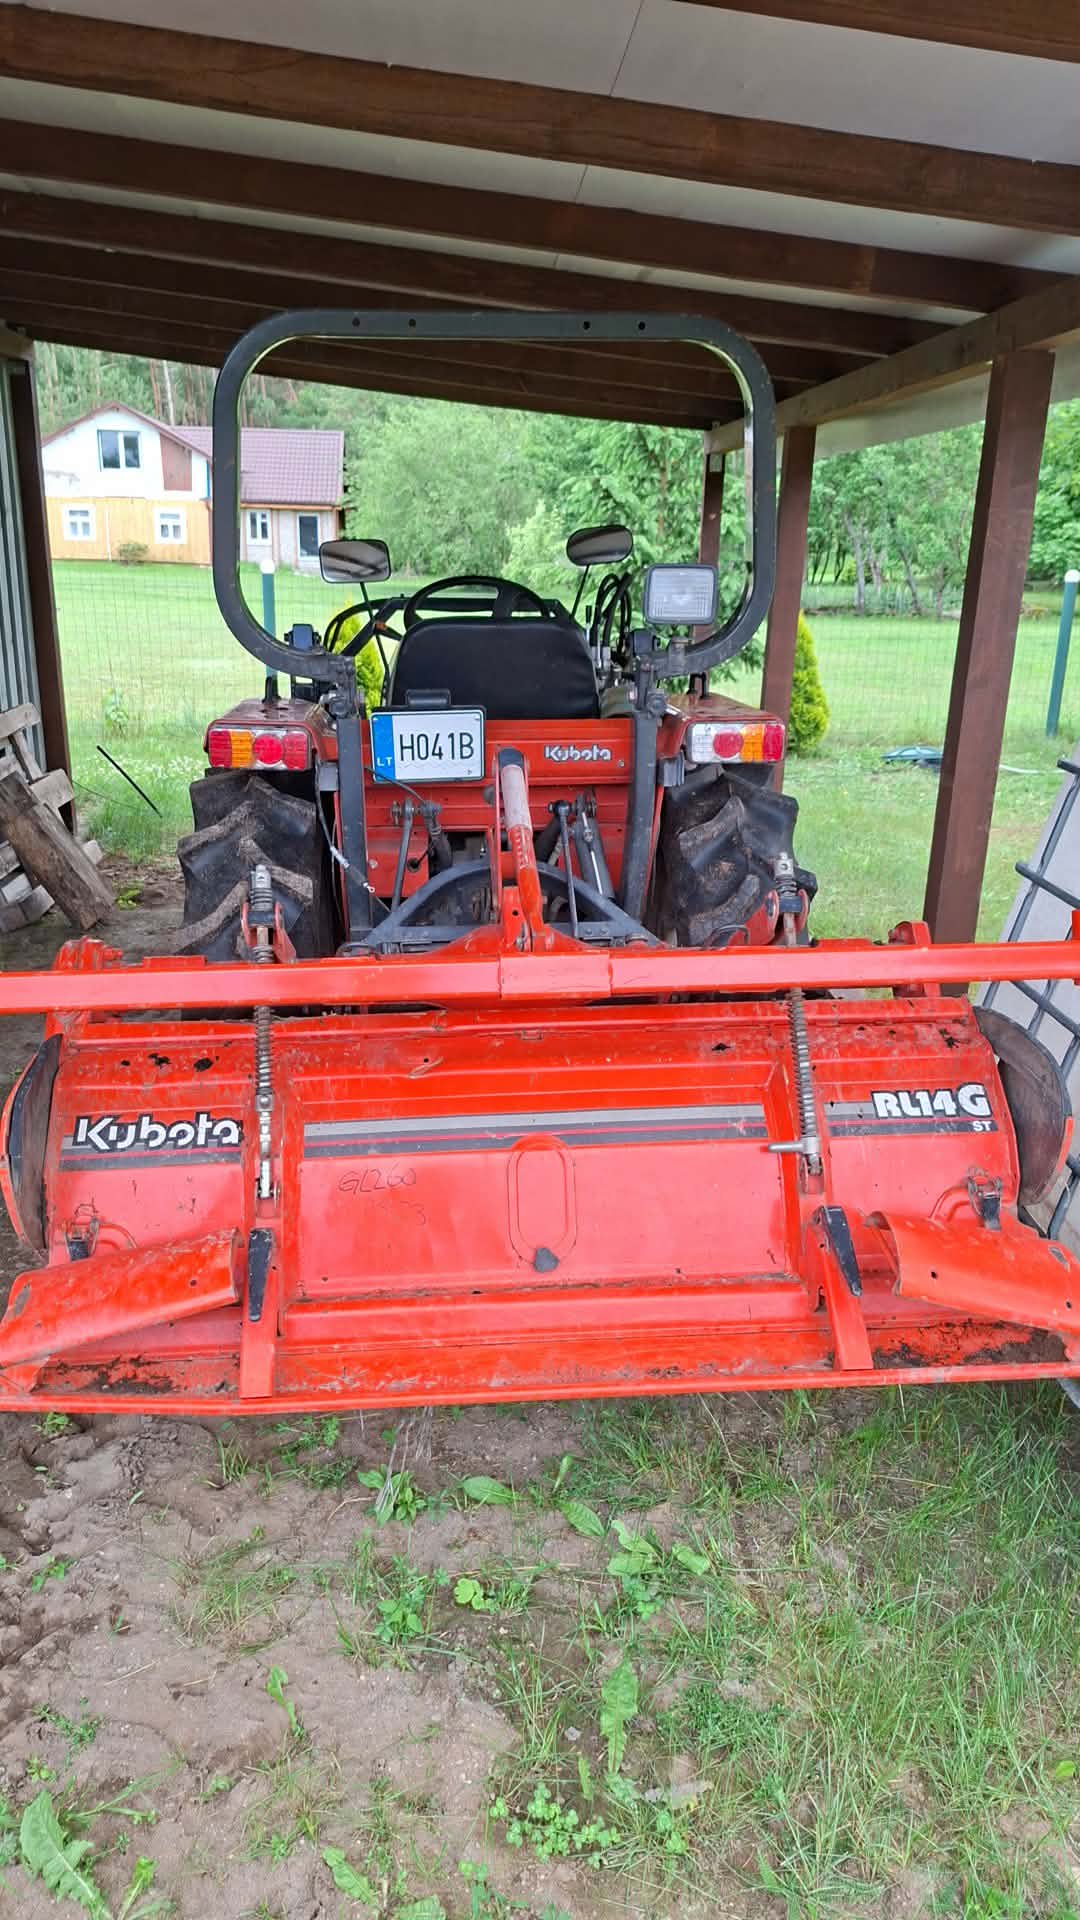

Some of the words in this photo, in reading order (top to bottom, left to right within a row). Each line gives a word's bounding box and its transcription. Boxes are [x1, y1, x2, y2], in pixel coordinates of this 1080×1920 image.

[399, 732, 474, 761] H041B
[544, 744, 612, 762] Kubota
[376, 757, 393, 767] LT
[872, 1083, 992, 1118] RL14G
[74, 1111, 243, 1152] Kubota
[972, 1120, 992, 1132] ST
